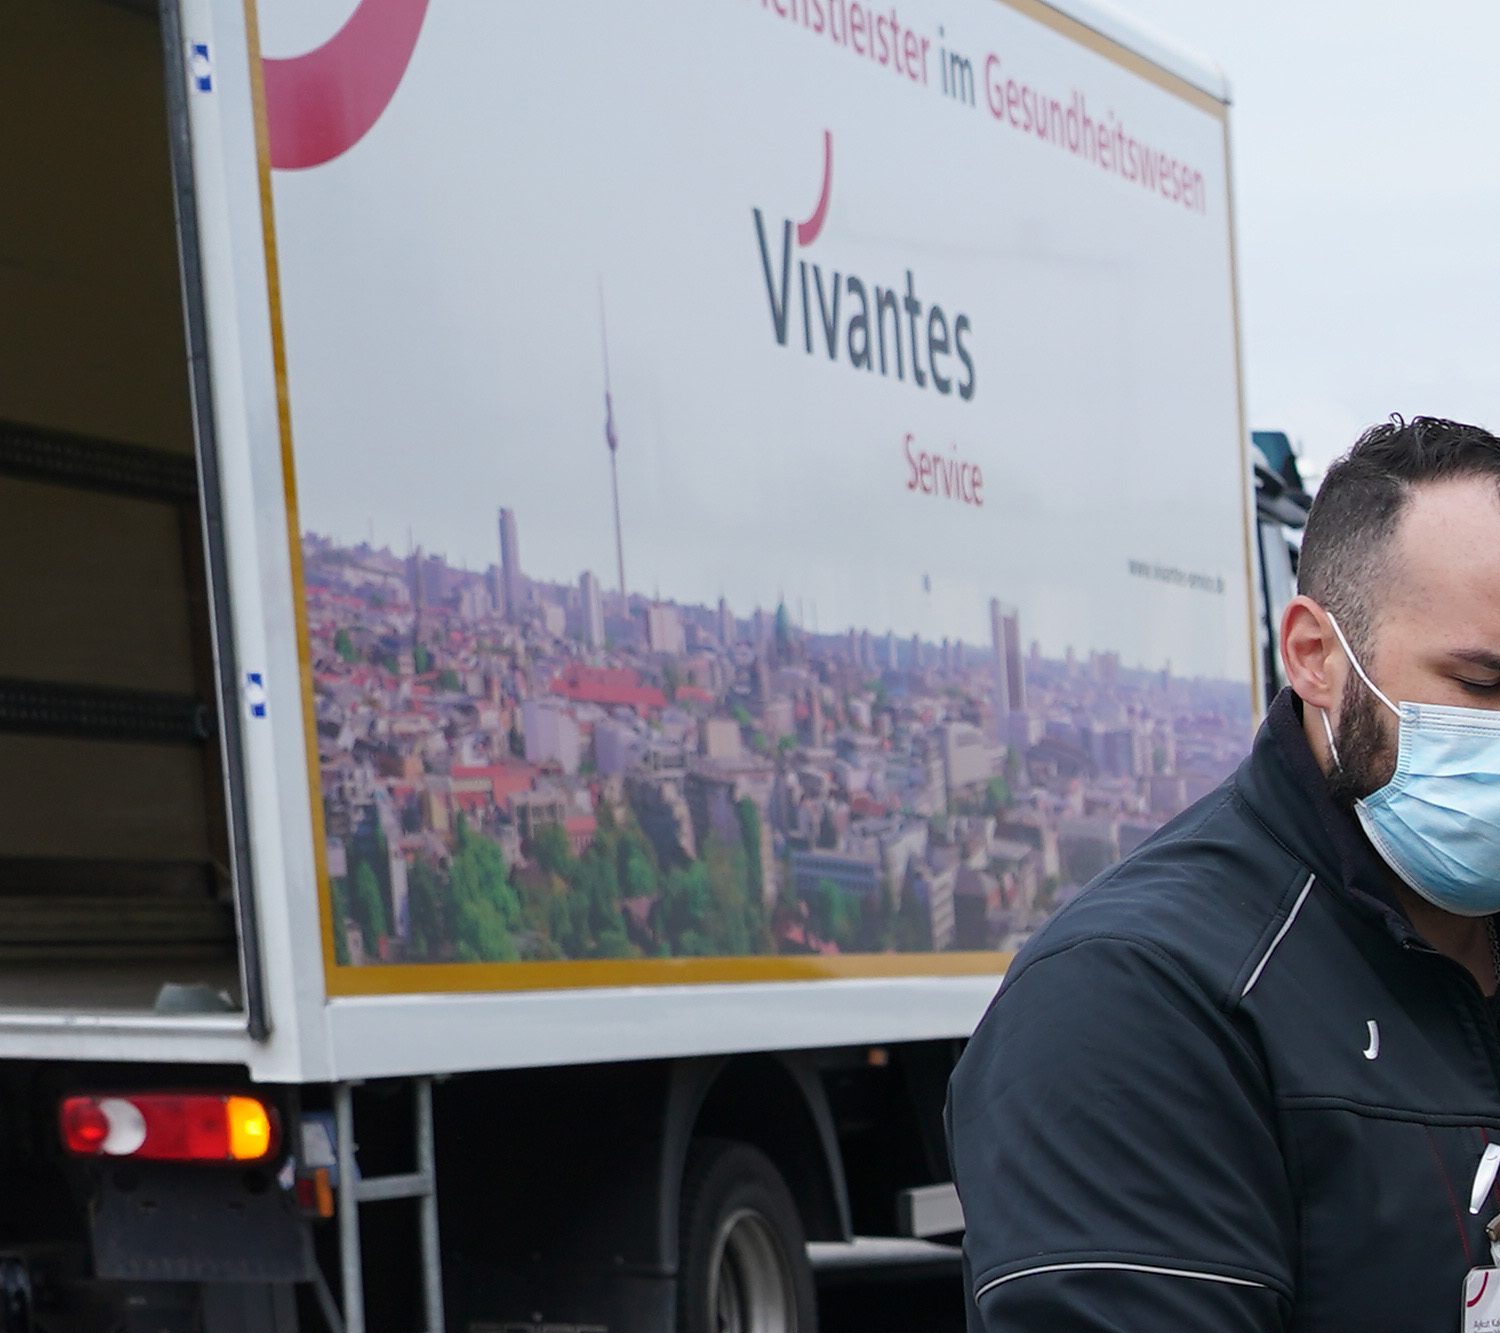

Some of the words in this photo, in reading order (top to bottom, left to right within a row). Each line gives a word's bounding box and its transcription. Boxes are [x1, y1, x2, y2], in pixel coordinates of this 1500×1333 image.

[760, 0, 931, 86] nstleister
[938, 24, 976, 107] im
[985, 52, 1206, 216] Gesundheitswesen
[751, 170, 976, 402] Vivantes
[903, 432, 985, 506] Service
